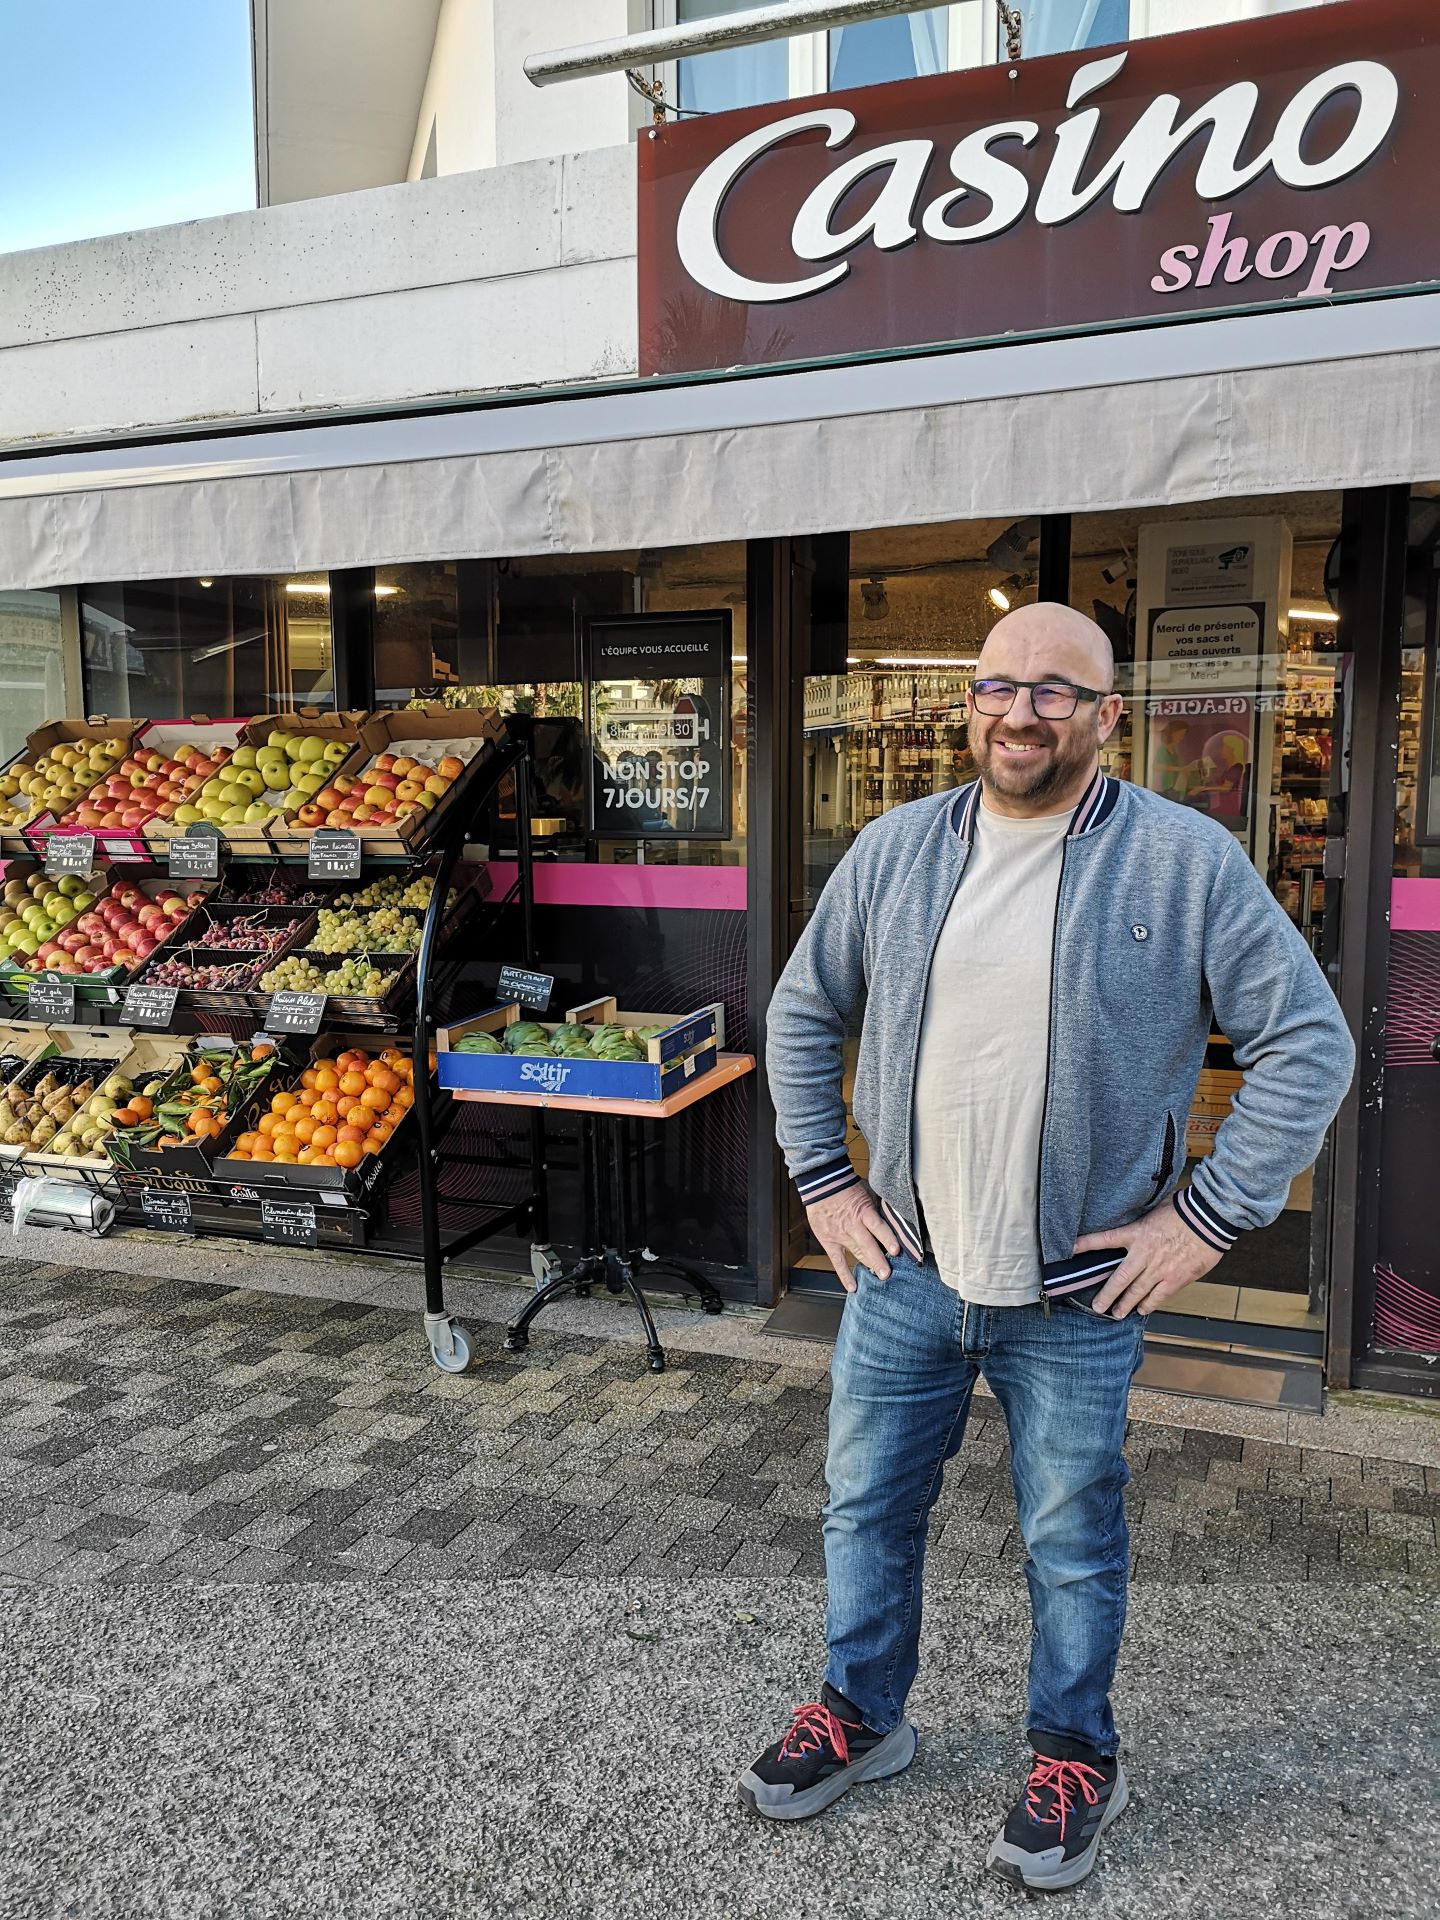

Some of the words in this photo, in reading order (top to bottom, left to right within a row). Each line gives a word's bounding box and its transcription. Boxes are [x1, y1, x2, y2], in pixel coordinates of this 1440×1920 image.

[676, 51, 1399, 302] Casino
[1151, 211, 1370, 298] shop
[1156, 624, 1185, 633] Merci
[1187, 623, 1200, 631] de
[1204, 621, 1256, 632] présenter
[601, 646, 638, 655] L'ÉQUIPE
[639, 645, 662, 653] VOUS
[664, 643, 709, 652] ACCUEILLE
[1168, 648, 1198, 656] cabas
[1202, 646, 1241, 655] ouverts
[1190, 671, 1219, 680] Merci
[655, 722, 690, 736] 9h30
[603, 761, 650, 780] NON
[656, 761, 710, 780] STOP
[603, 786, 710, 810] 7JOURS/7
[520, 1062, 571, 1082] Soltir
